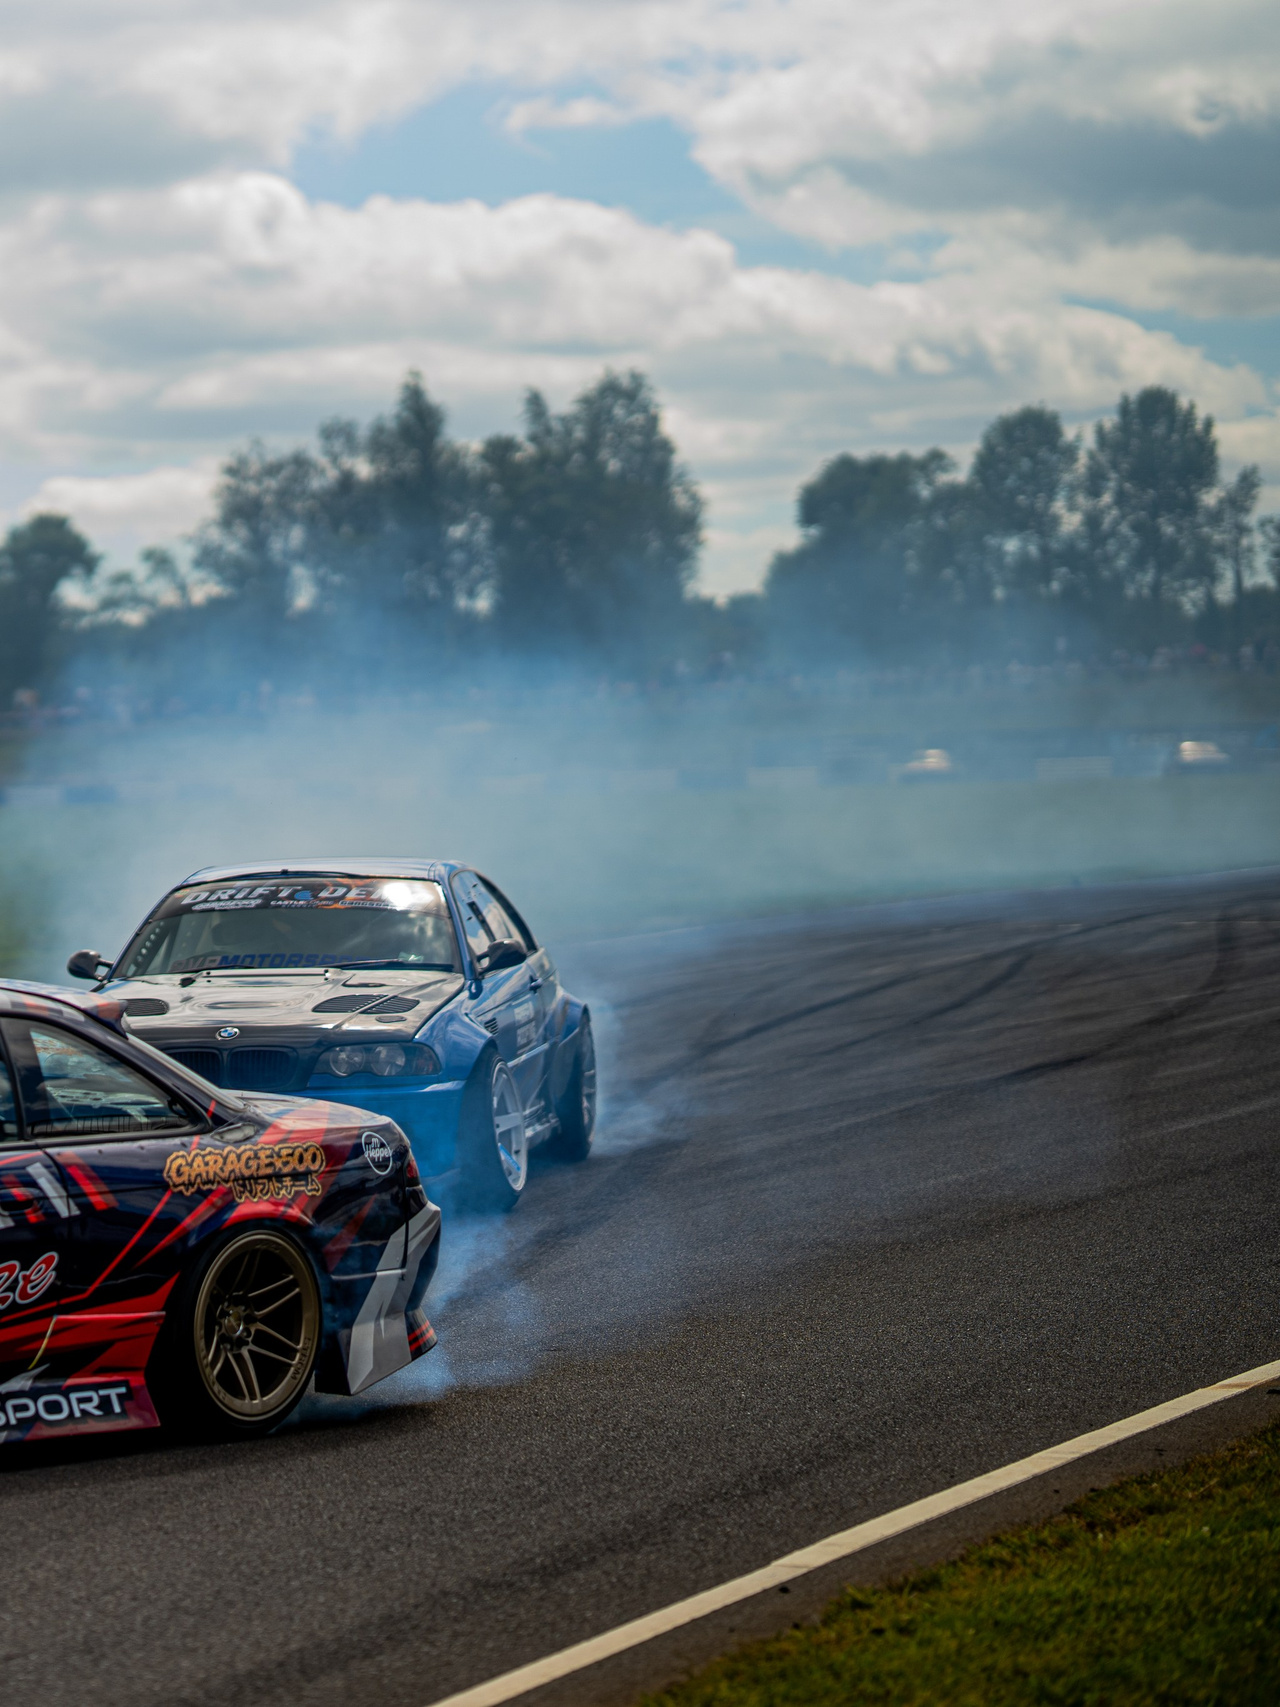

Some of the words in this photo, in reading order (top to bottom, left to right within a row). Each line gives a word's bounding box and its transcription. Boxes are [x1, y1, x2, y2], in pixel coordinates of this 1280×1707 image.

[181, 886, 302, 904] DRIFT
[218, 952, 380, 970] MOTORSPO
[168, 1148, 274, 1188] GARAGE
[277, 1145, 323, 1172] 500
